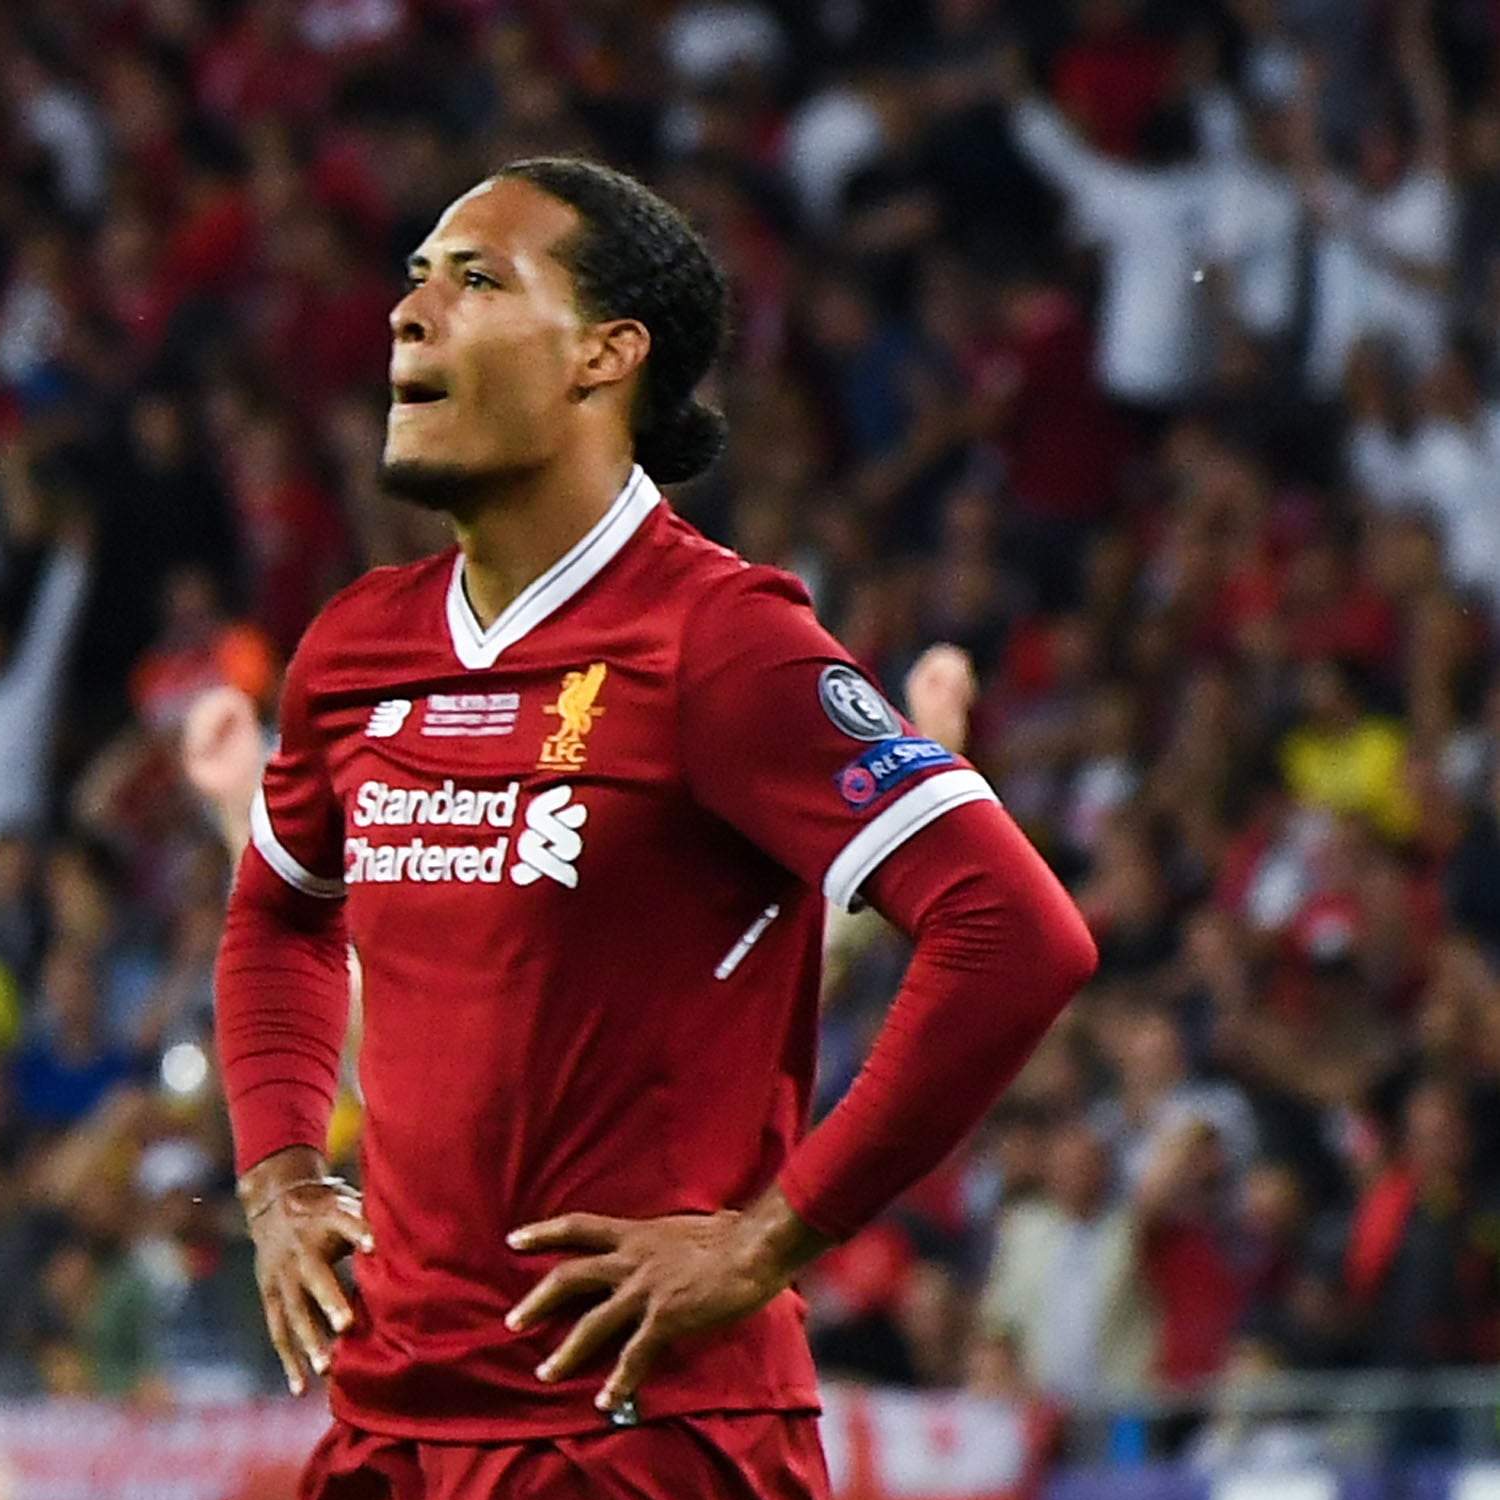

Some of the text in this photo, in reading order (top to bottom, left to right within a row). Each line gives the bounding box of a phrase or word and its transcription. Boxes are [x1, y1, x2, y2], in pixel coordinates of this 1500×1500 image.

[539, 742, 588, 762] LFC
[869, 743, 948, 780] RESP
[353, 779, 520, 827] Standard
